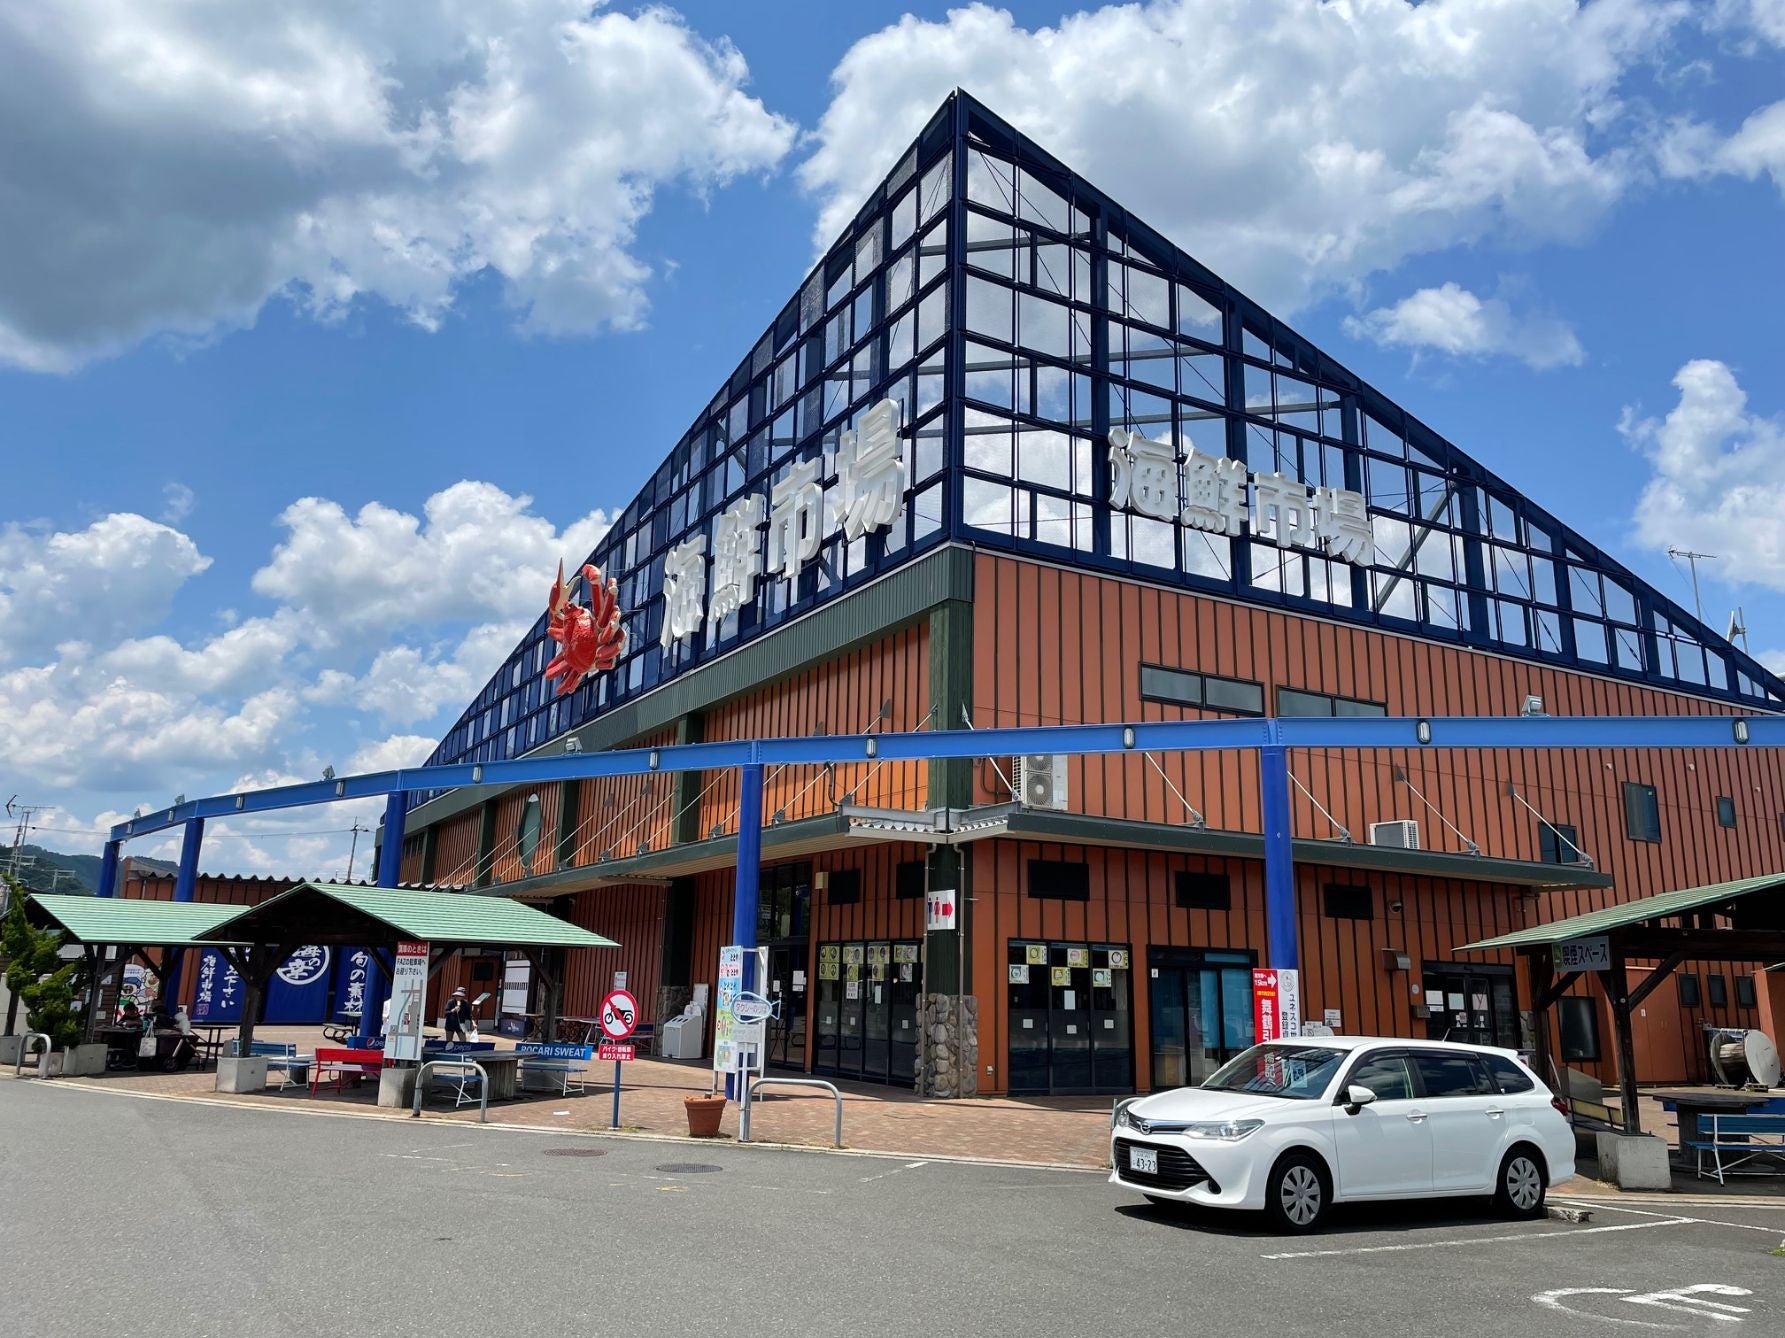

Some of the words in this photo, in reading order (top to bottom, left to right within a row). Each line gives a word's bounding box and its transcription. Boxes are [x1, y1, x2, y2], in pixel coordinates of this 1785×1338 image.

[660, 399, 904, 646] 海鮮市場
[1108, 428, 1374, 567] 海鮮市場
[197, 955, 217, 1003] 海鮮市場
[344, 951, 369, 1012] 旬の素材
[1562, 943, 1608, 966] 喫煙スペース
[554, 1046, 586, 1058] SWEAT
